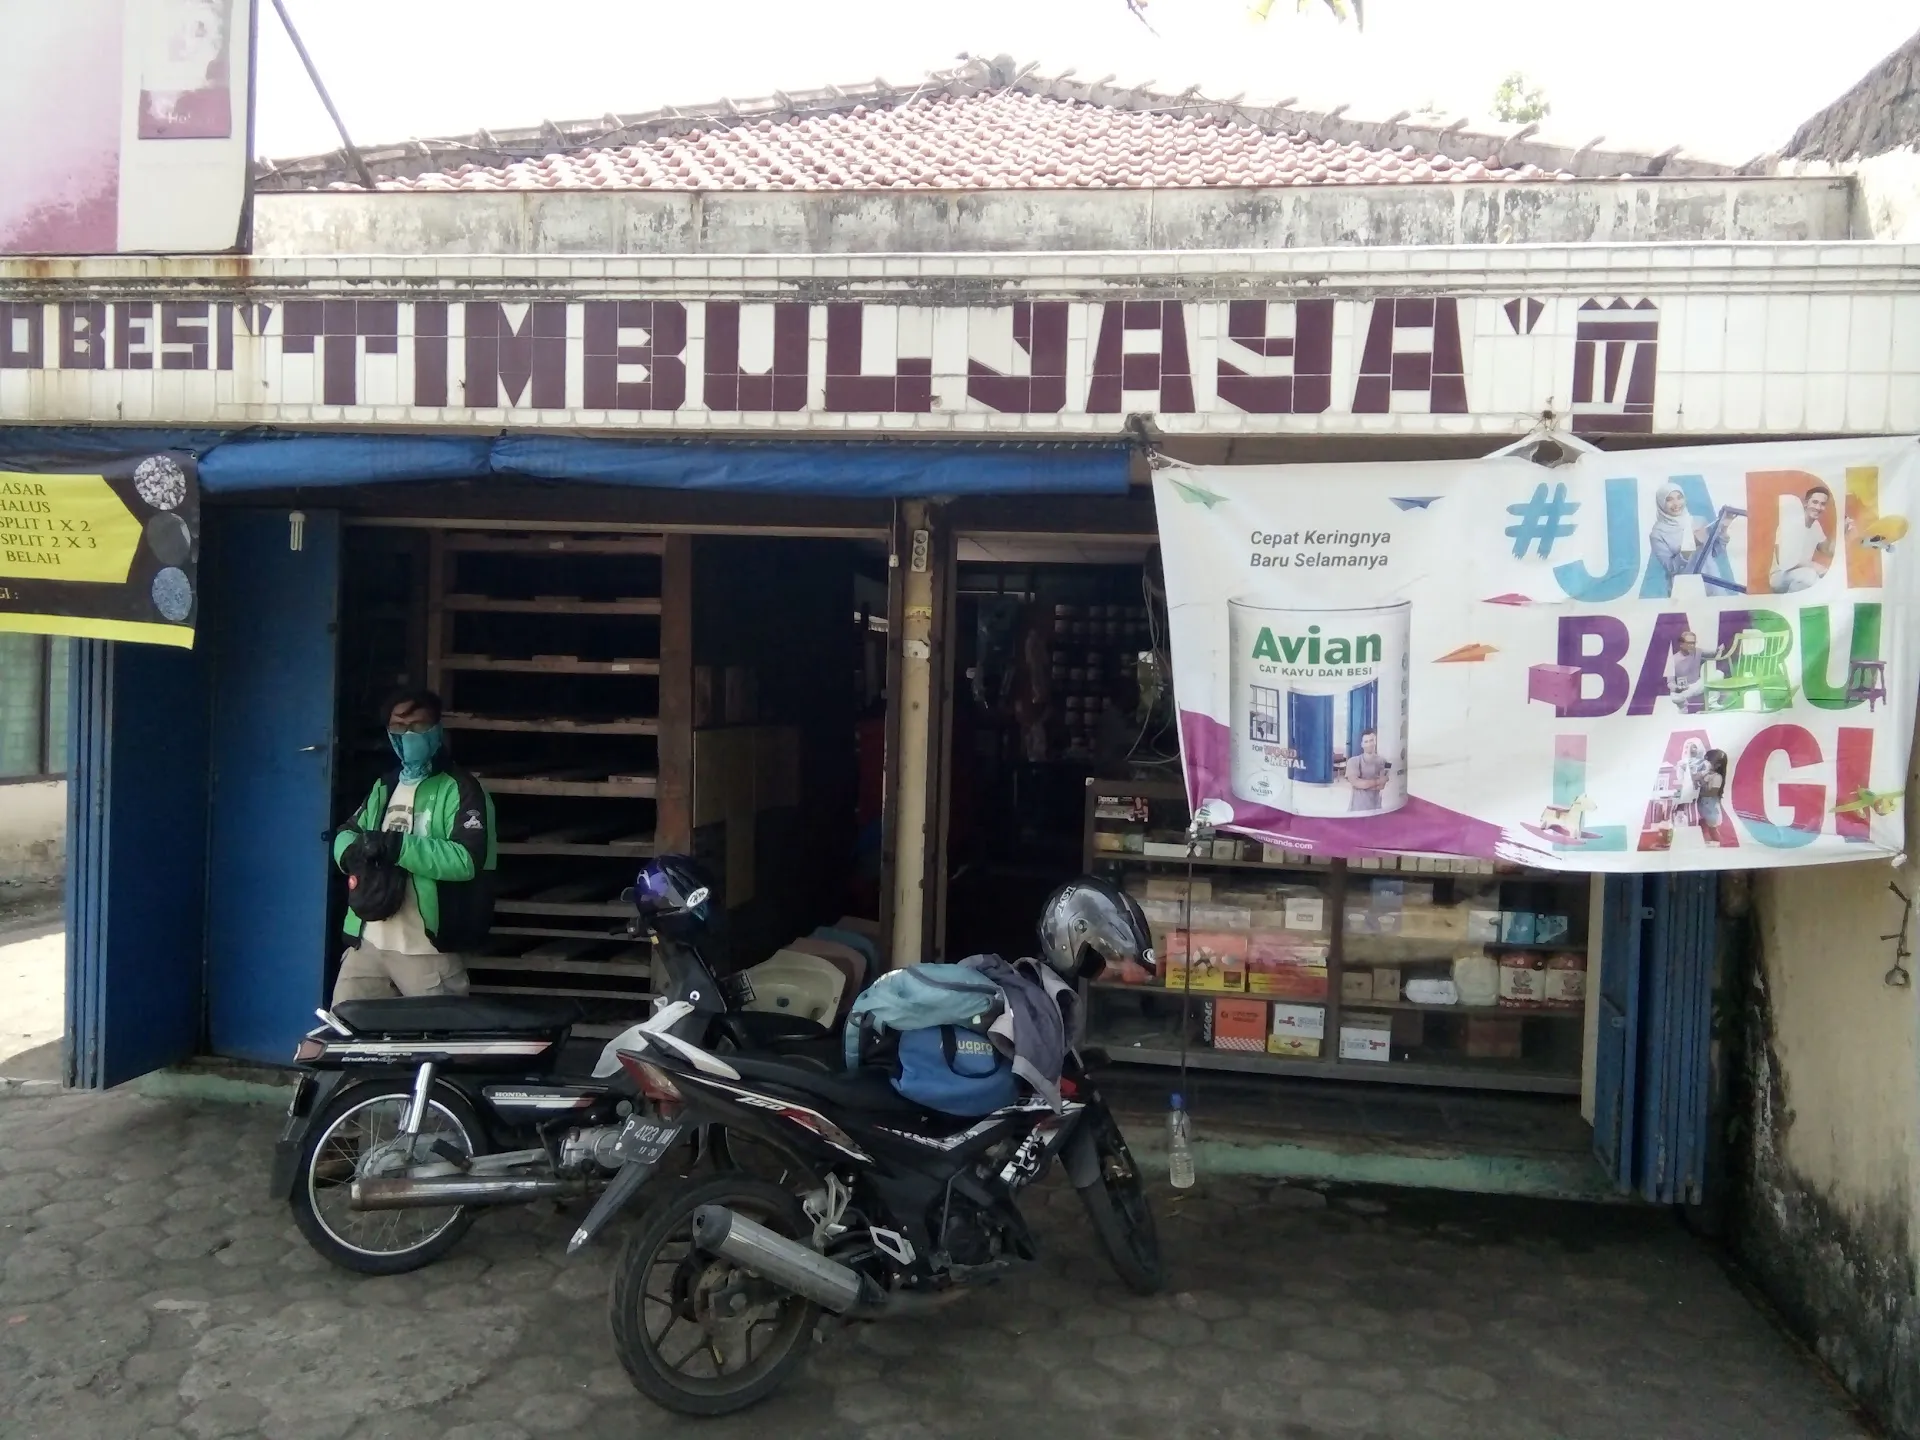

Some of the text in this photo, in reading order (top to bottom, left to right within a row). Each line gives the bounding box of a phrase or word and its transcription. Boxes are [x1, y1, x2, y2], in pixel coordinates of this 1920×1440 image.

[59, 301, 233, 370] BESI
[0, 483, 46, 496] ASAR
[47, 519, 54, 531] 1
[80, 520, 91, 532] 2
[1, 533, 96, 549] SPLIT 2 X 3
[1251, 530, 1391, 548] Cepat Keringnya
[6, 550, 61, 565] BELAH
[1250, 552, 1389, 570] Baru Selamanya
[1252, 625, 1382, 665] Avian
[1555, 602, 1882, 718] BARU
[1259, 664, 1372, 677] CAT KAYU DAN BESI
[1271, 757, 1306, 770] METAL
[1552, 724, 1875, 852] LAGI
[634, 1124, 660, 1143] 4123
